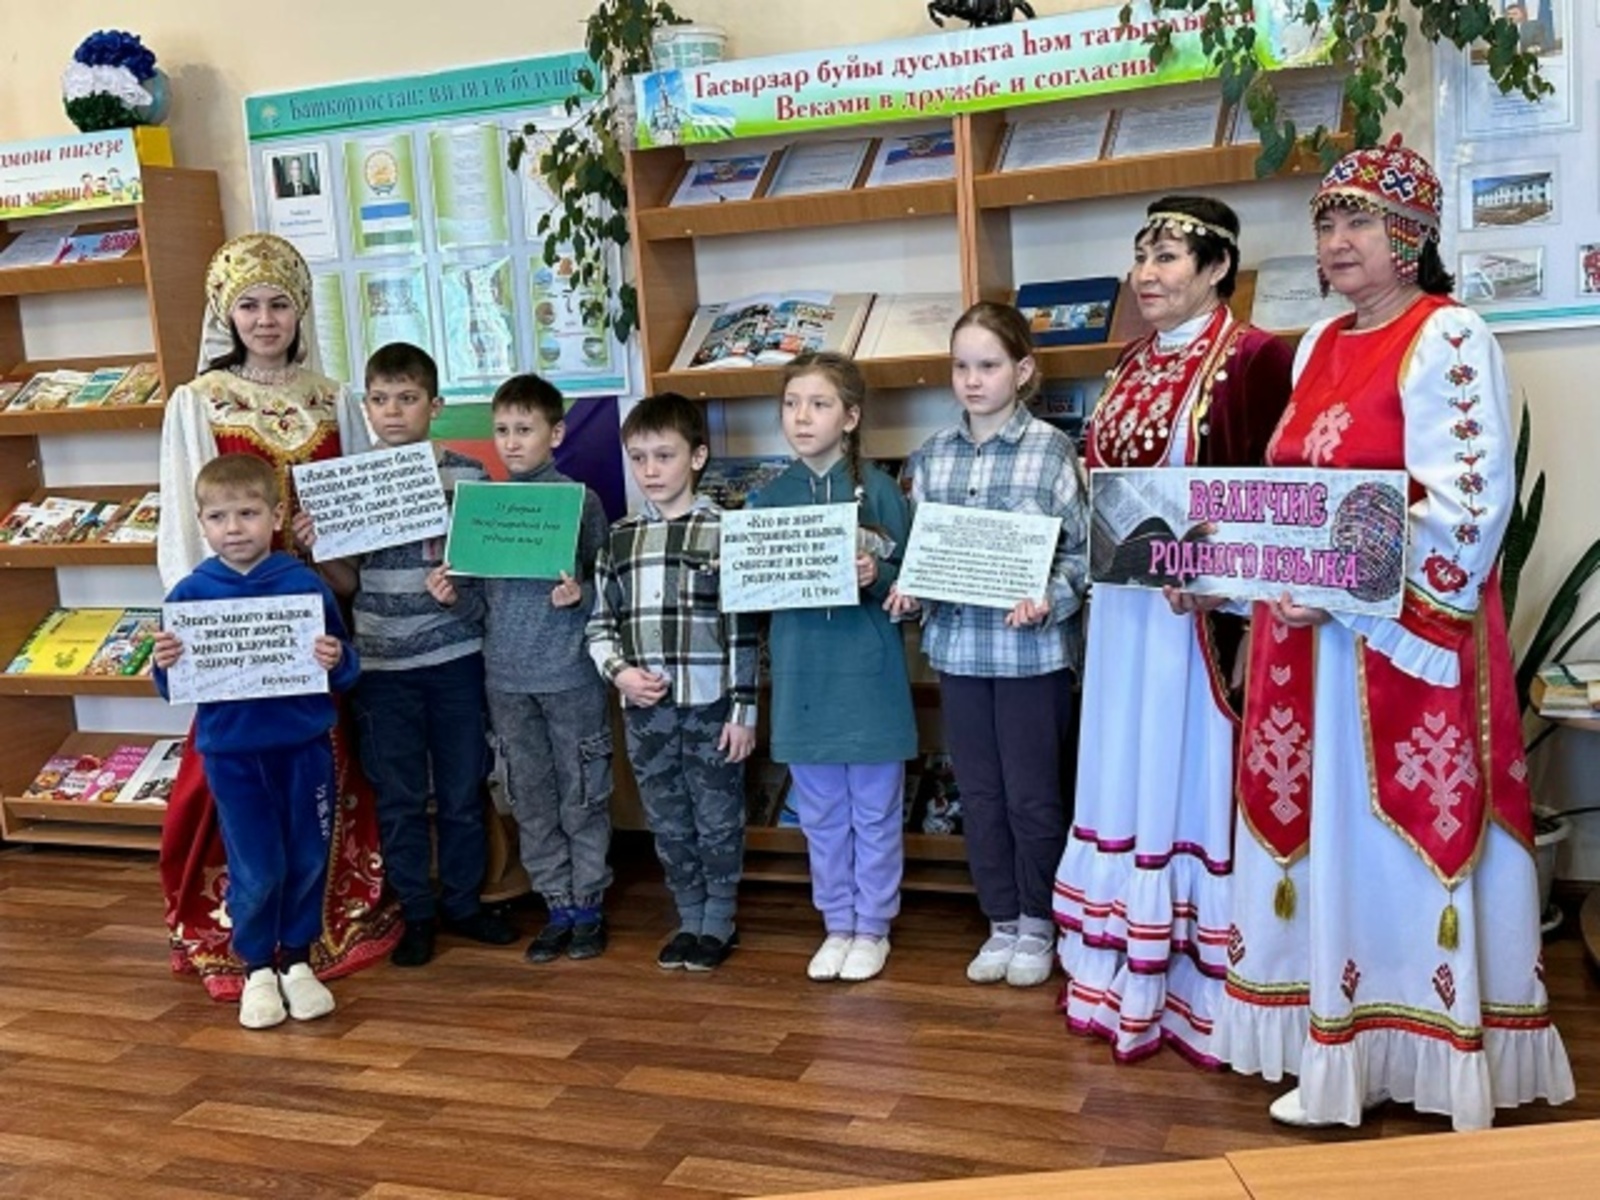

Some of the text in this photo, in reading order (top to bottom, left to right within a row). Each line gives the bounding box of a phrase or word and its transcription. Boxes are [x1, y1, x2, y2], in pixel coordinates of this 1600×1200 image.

[817, 54, 884, 88] буйы
[775, 58, 1157, 121] Веками в дружбе и согласии
[340, 466, 353, 477] не
[356, 457, 393, 471] может
[395, 452, 426, 464] быть
[1188, 480, 1328, 527] ВЕЛИЧИЕ
[777, 517, 790, 527] не
[792, 515, 825, 526] знает
[724, 530, 802, 545] иностранных
[747, 542, 826, 556] тот ничего не
[796, 557, 803, 567] в
[1149, 540, 1359, 588] РОДНОГО ЯЗЫКА
[742, 572, 786, 588] родном
[221, 612, 263, 624] много
[253, 624, 294, 637] иметь
[191, 638, 298, 655] много ключей к
[195, 657, 246, 669] одному
